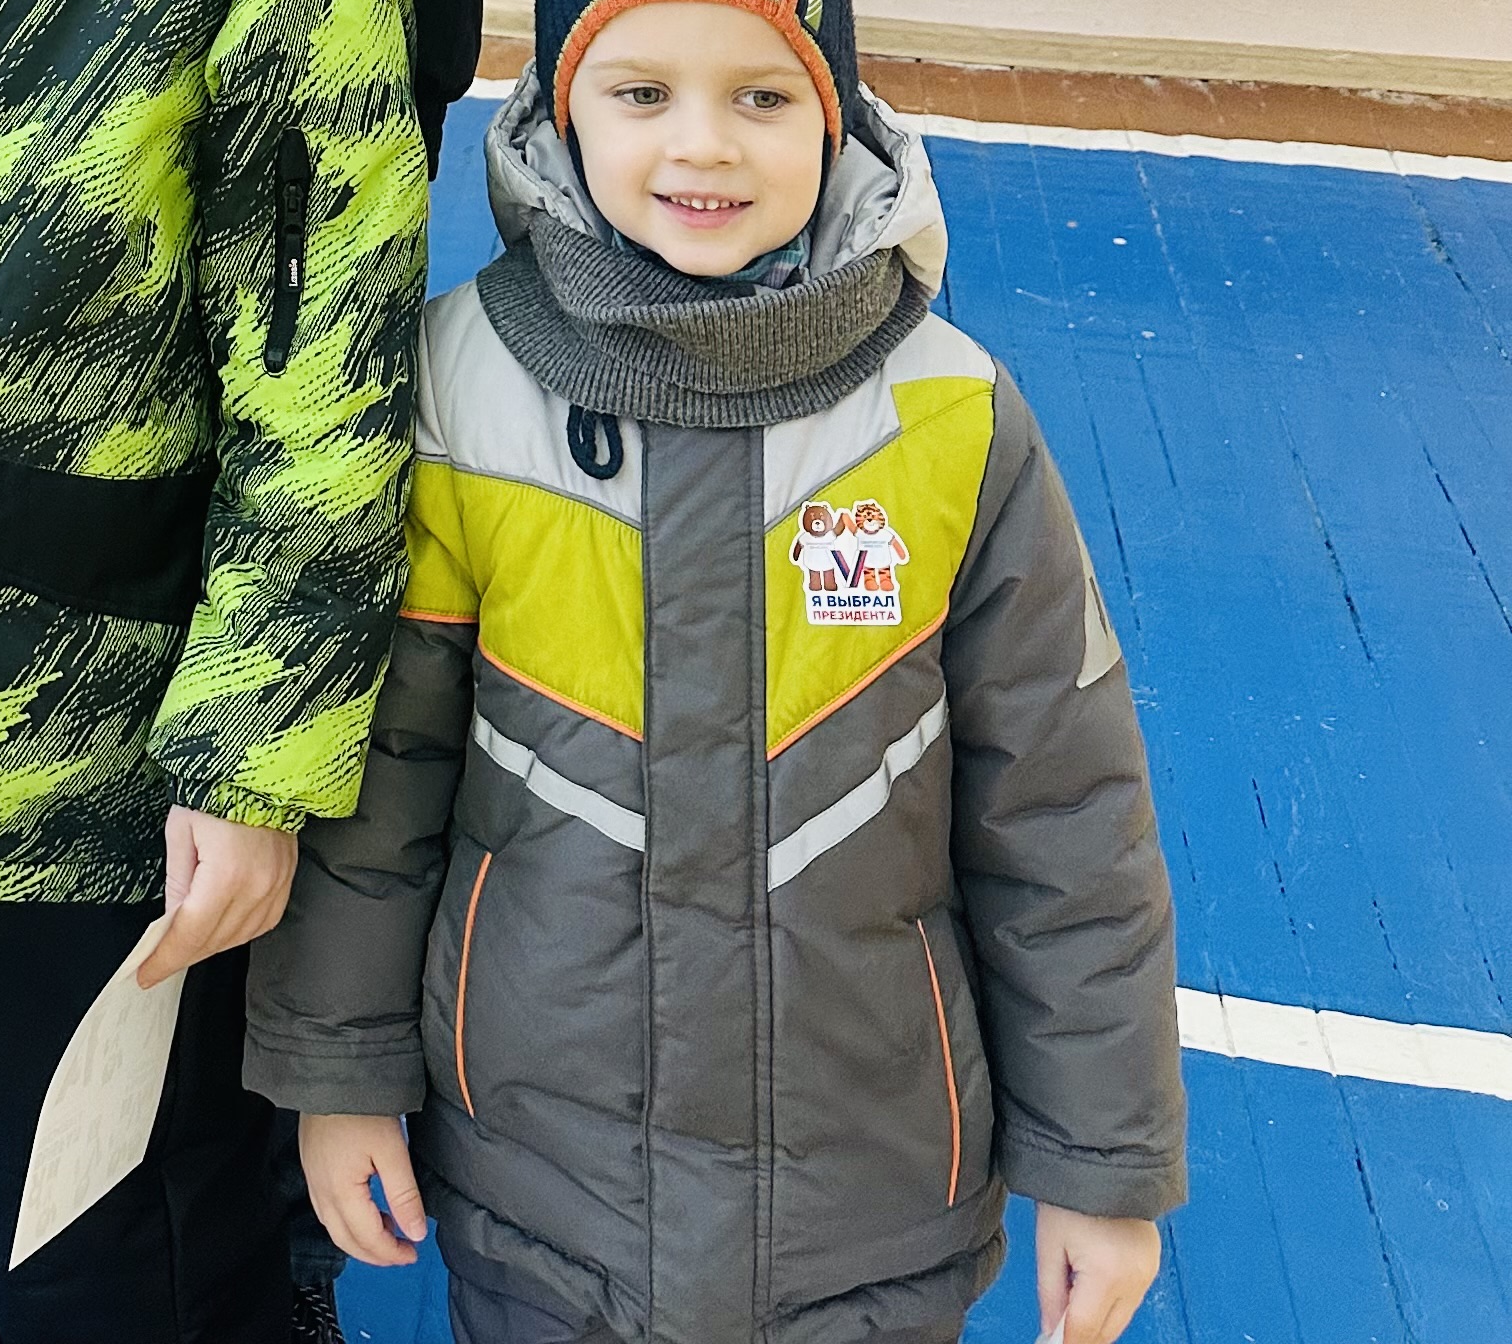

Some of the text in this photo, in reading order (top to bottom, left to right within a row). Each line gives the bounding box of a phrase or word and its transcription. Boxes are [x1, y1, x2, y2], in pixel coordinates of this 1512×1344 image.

[811, 595, 895, 608] Я ВЫБРАЛ
[813, 610, 896, 622] ПРЕЗИДЕНТА
